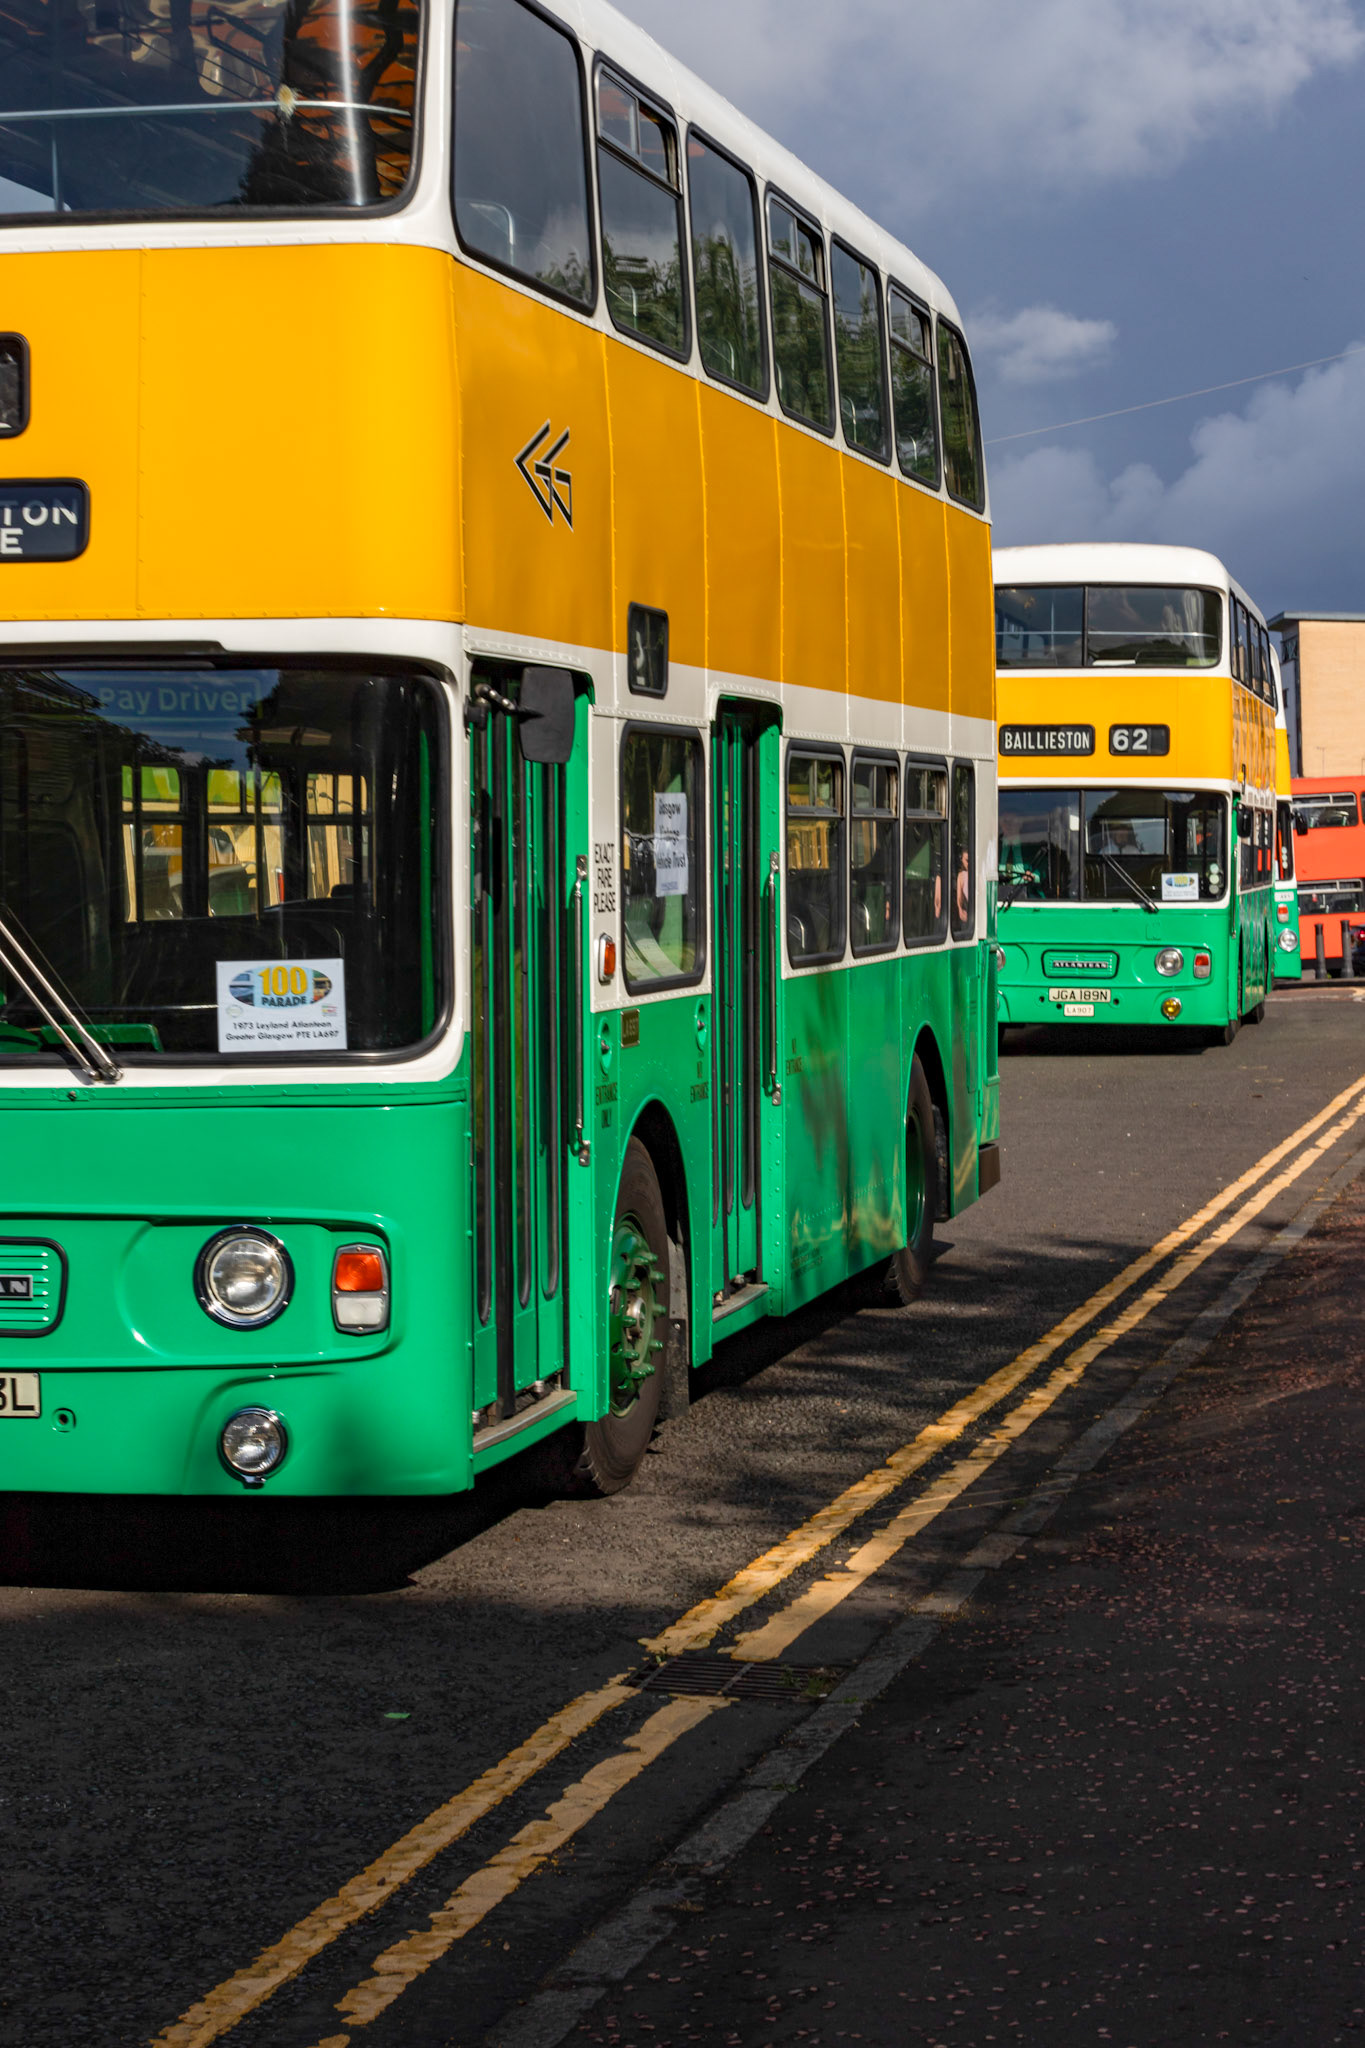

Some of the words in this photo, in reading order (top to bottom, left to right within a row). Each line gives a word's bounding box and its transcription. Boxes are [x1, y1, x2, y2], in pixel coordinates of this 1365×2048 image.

[99, 687, 150, 715] Pay
[158, 686, 251, 712] Driver
[1004, 731, 1090, 750] BAILLIESTON
[1112, 728, 1148, 751] 62
[595, 843, 615, 864] EXACT
[597, 867, 613, 889] FARE
[594, 891, 616, 914] PLEASE
[258, 965, 308, 997] 100
[260, 996, 308, 1008] PARADE
[1052, 989, 1077, 1001] JGA
[1080, 989, 1108, 1001] 189N
[225, 1032, 256, 1041] Greater
[257, 1032, 294, 1042] Glasgow
[296, 1031, 311, 1039] PTE
[233, 1022, 255, 1030] 1973
[256, 1021, 289, 1031] Leyland
